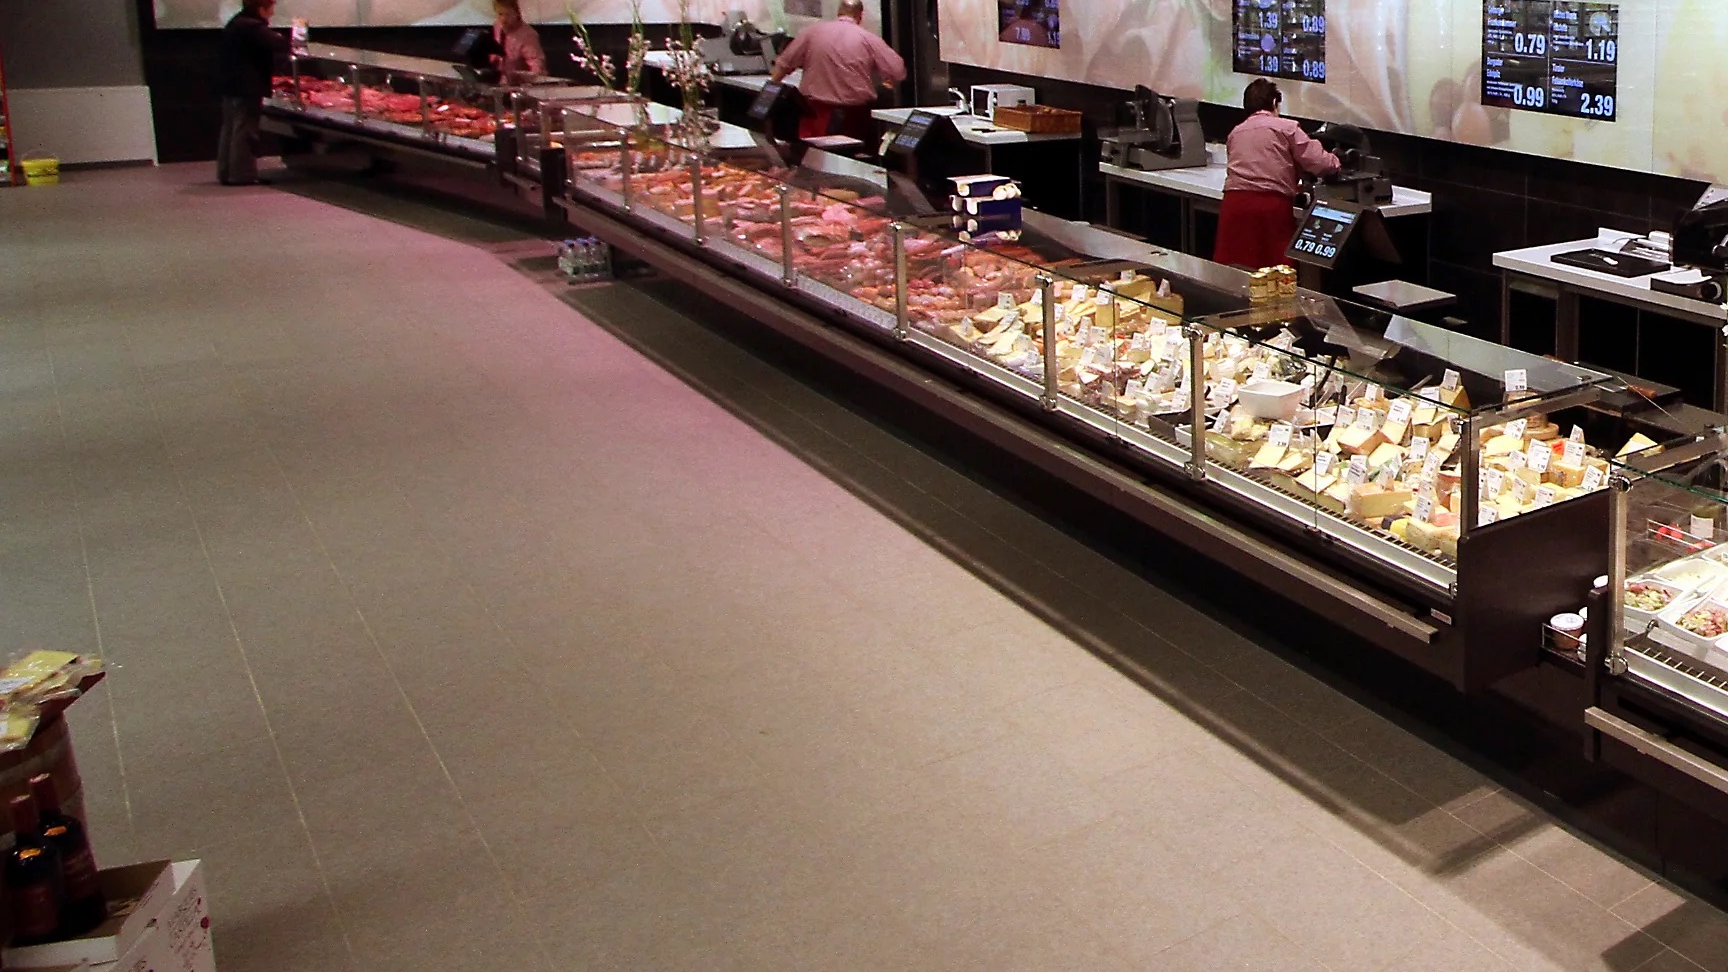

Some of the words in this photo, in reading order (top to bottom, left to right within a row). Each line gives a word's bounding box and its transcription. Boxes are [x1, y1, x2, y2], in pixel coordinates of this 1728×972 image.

[1514, 33, 1546, 55] 0.79
[1586, 39, 1616, 62] 1.19
[1513, 85, 1544, 108] 0.99
[1580, 93, 1613, 116] 2.39
[1295, 239, 1315, 252] 0.79
[1315, 244, 1336, 258] 0.99
